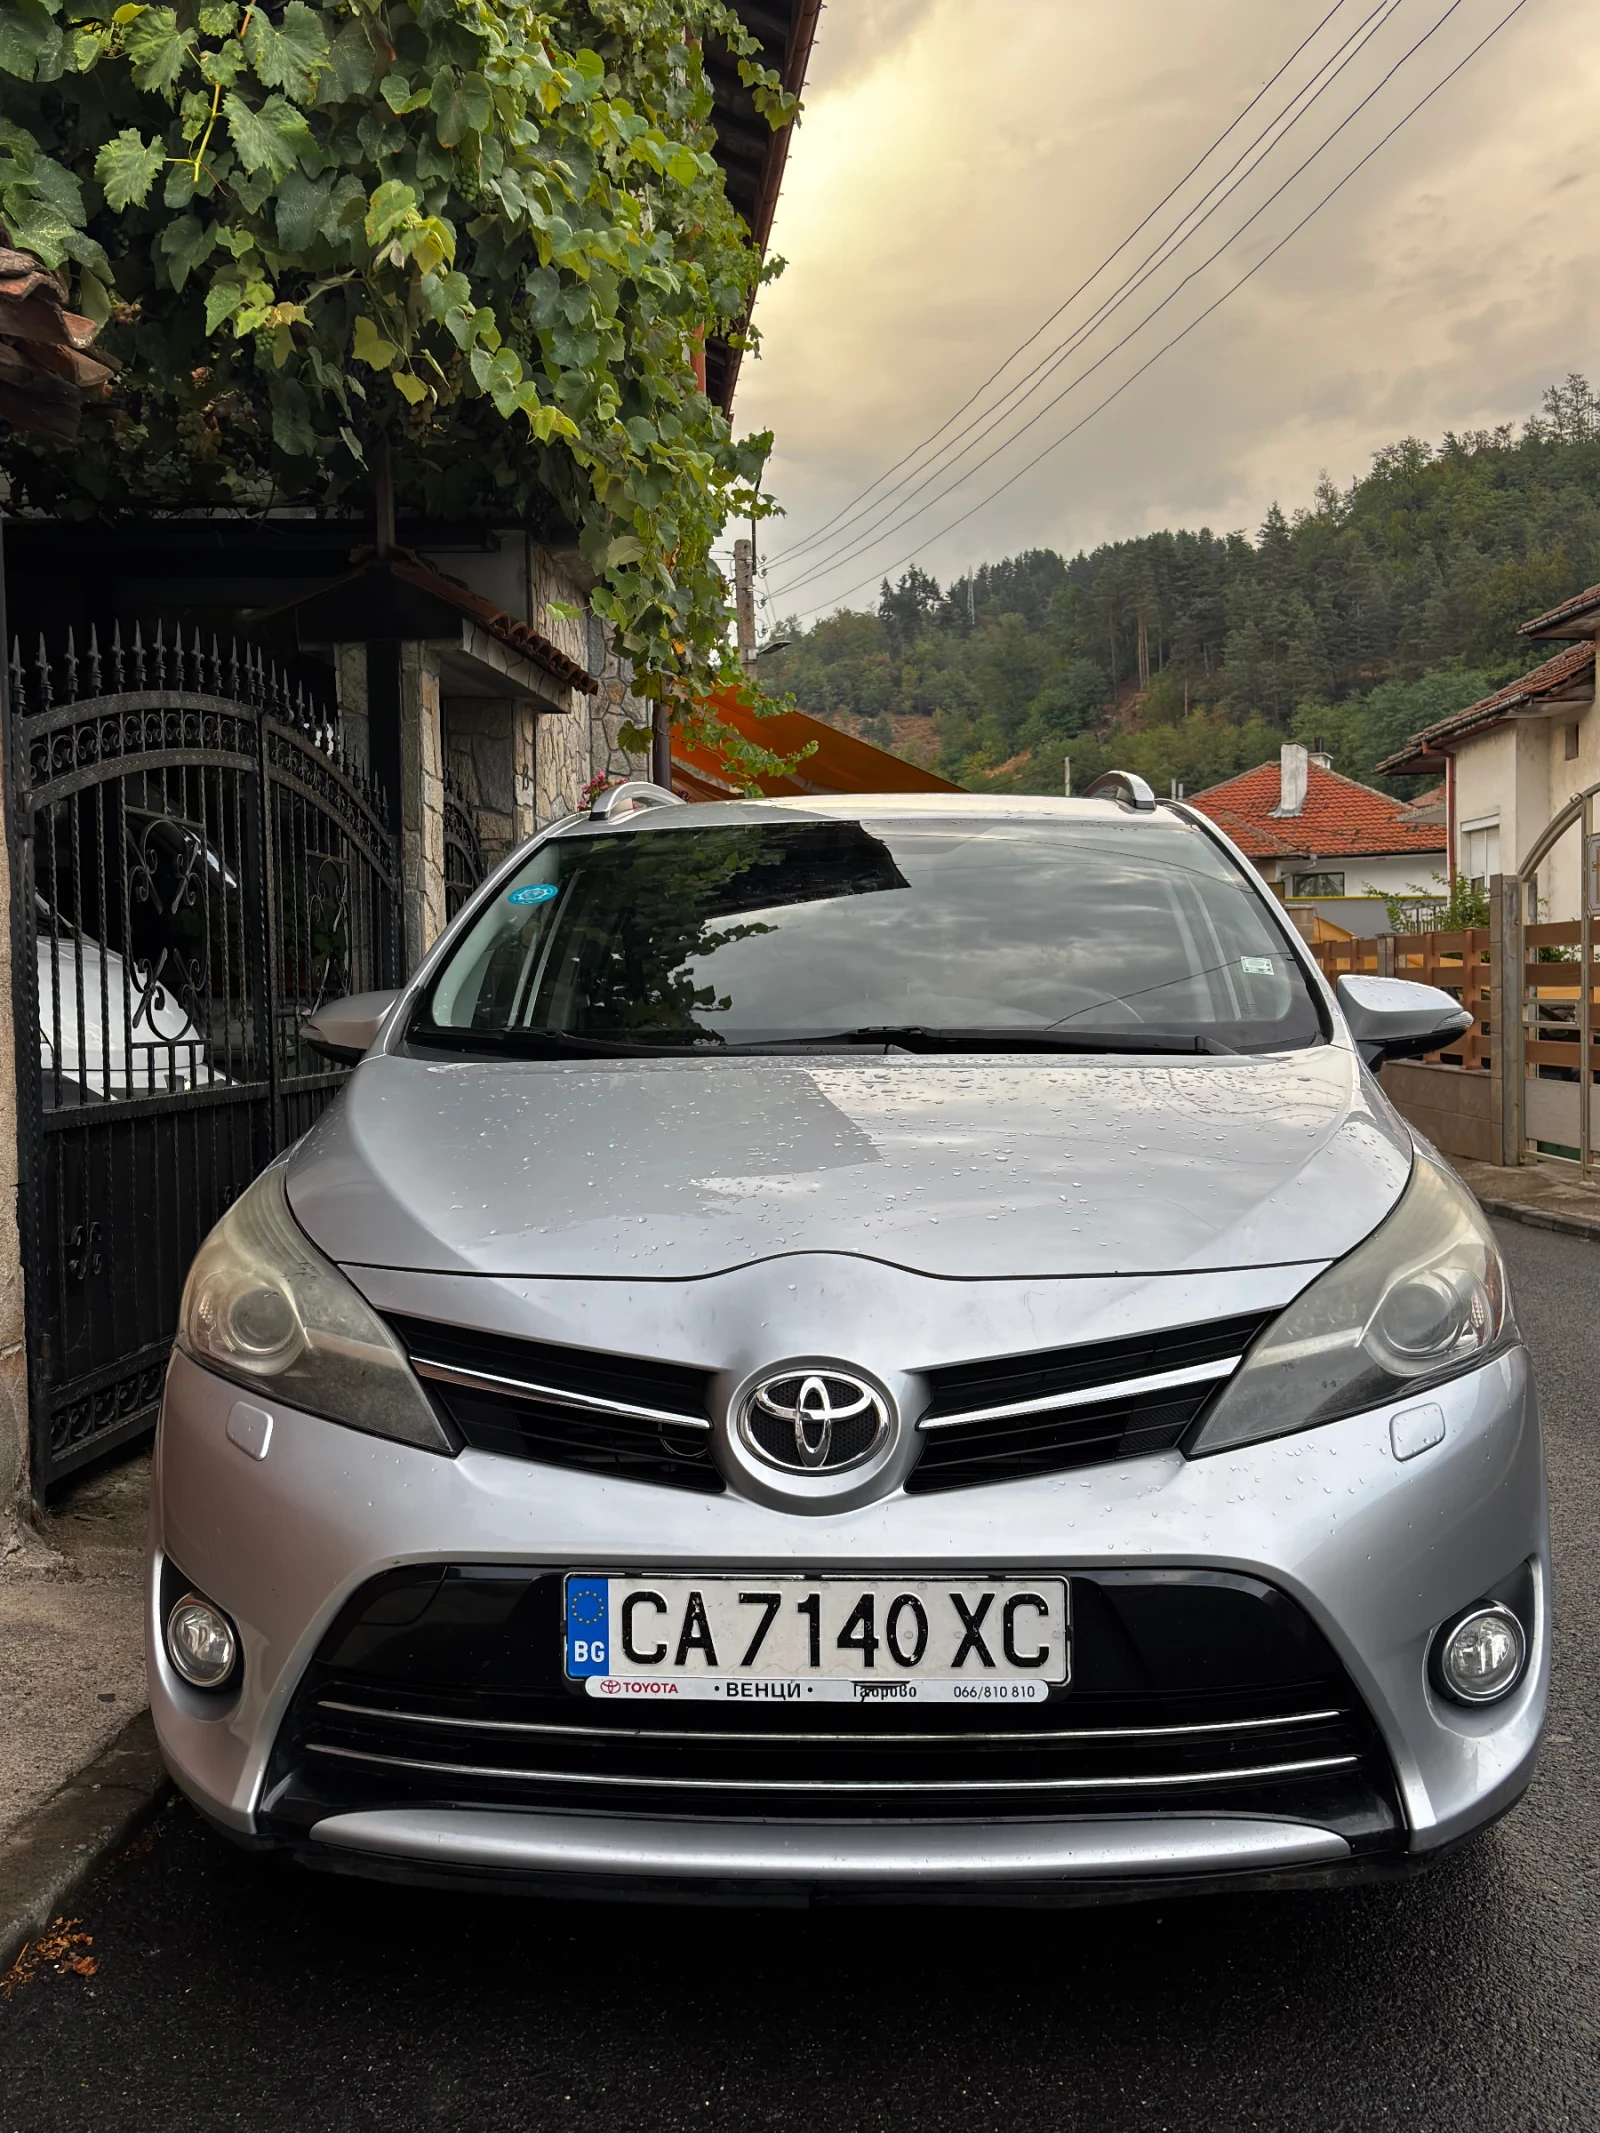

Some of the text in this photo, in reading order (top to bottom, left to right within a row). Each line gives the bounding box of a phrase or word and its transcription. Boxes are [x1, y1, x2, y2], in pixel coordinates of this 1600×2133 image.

[620, 1590, 1050, 1668] CA 7140 XC
[574, 1640, 605, 1663] BG
[623, 1682, 679, 1694] TOYOTA
[726, 1682, 801, 1700] ВЕНЦИ
[953, 1685, 1036, 1699] 066/810 810
